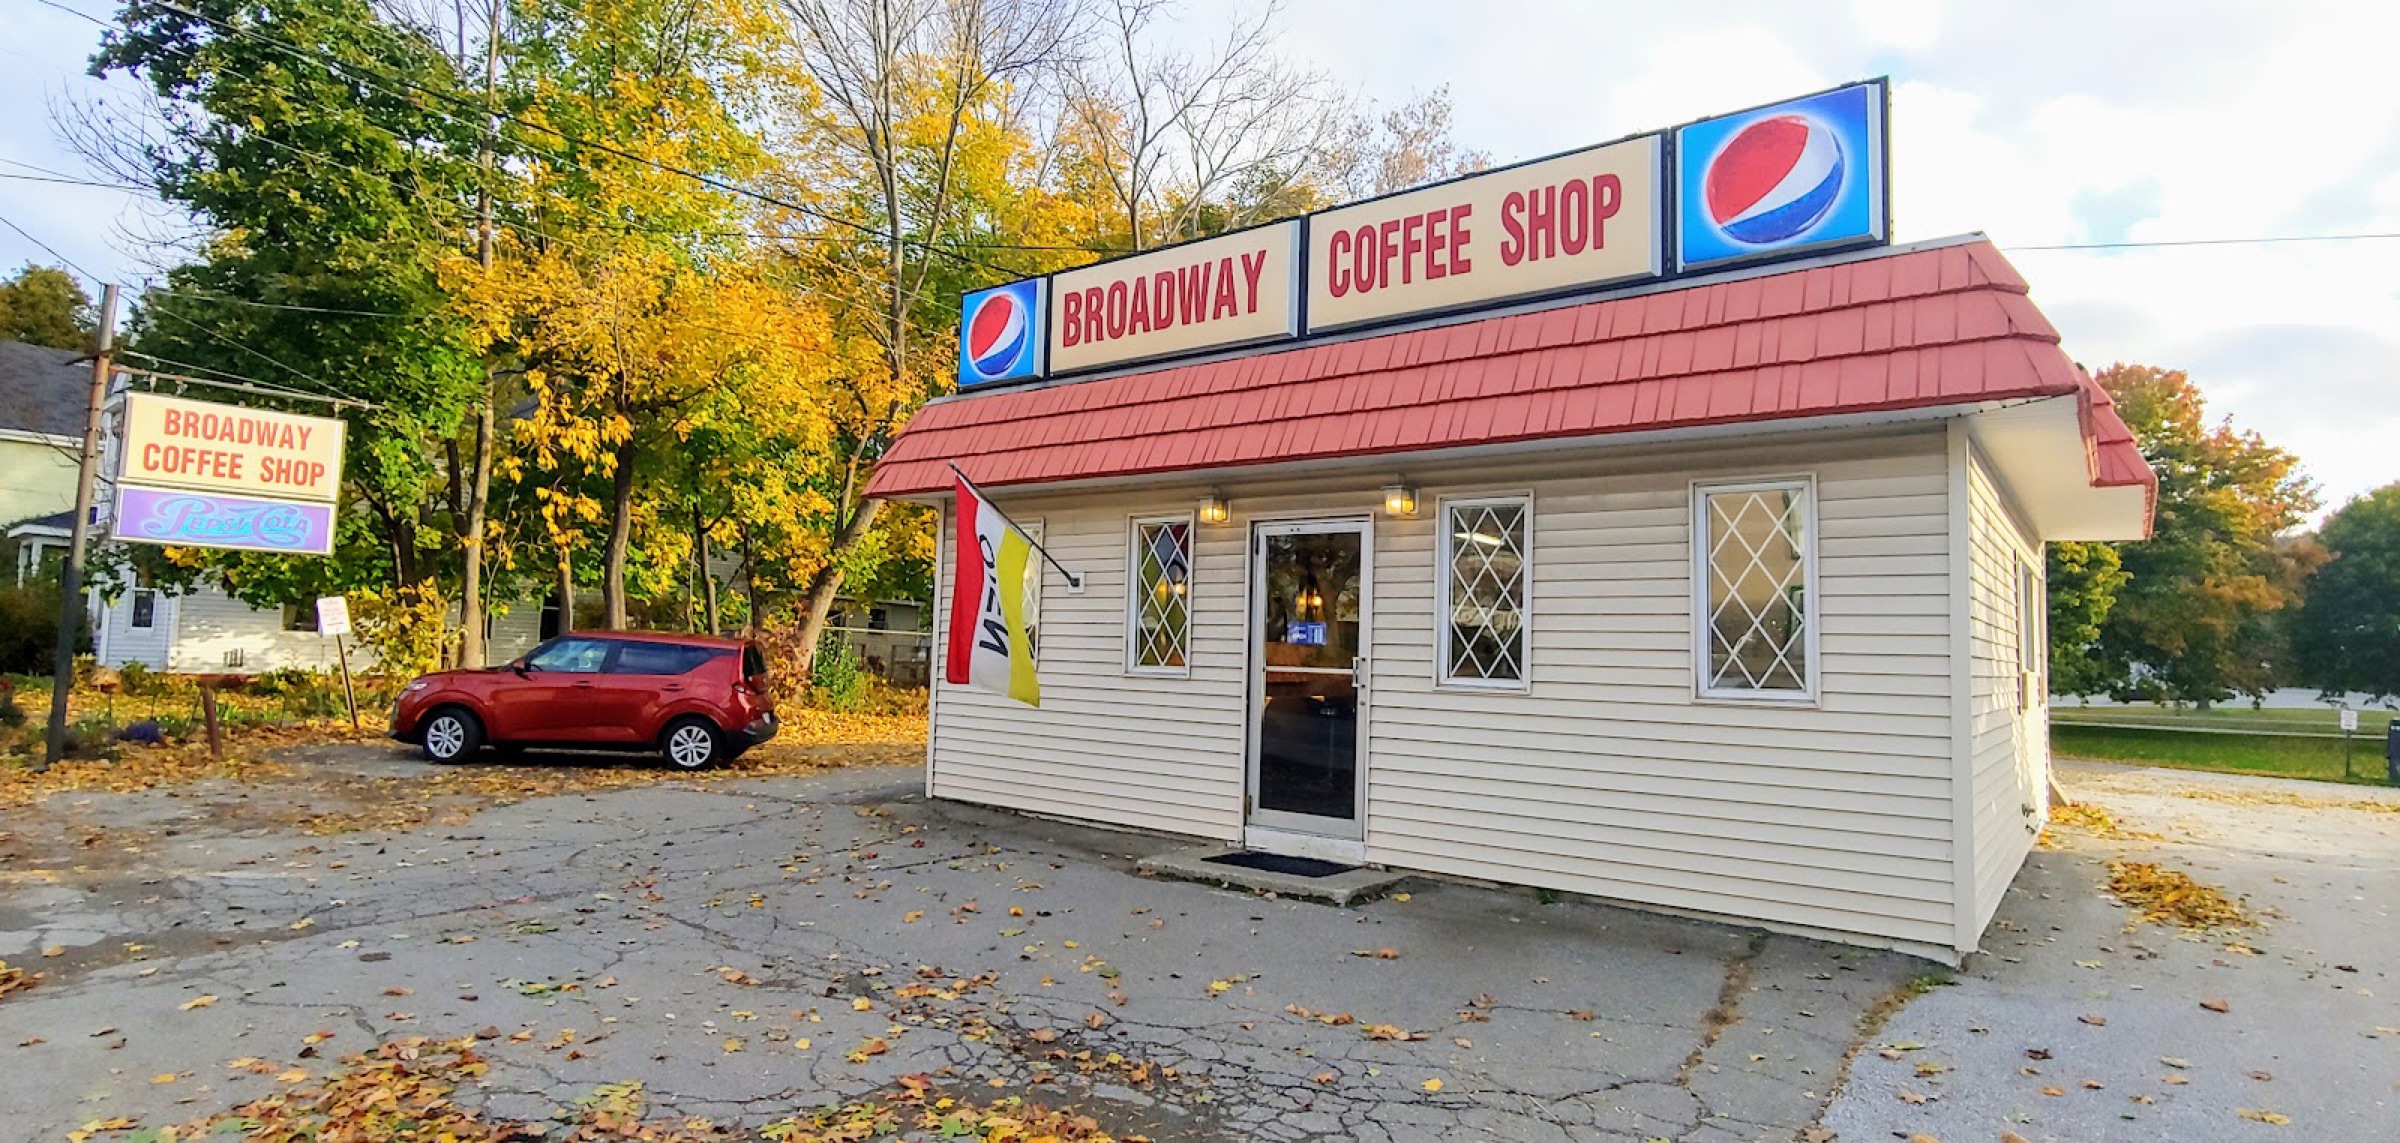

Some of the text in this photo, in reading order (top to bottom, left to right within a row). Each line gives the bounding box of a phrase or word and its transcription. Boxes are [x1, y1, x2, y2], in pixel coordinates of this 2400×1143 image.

[1328, 173, 1622, 298] COFFEE SHOP
[1062, 249, 1267, 348] BROADWAY
[143, 442, 325, 487] COFFEE SHOP
[163, 407, 313, 451] BROADWAY
